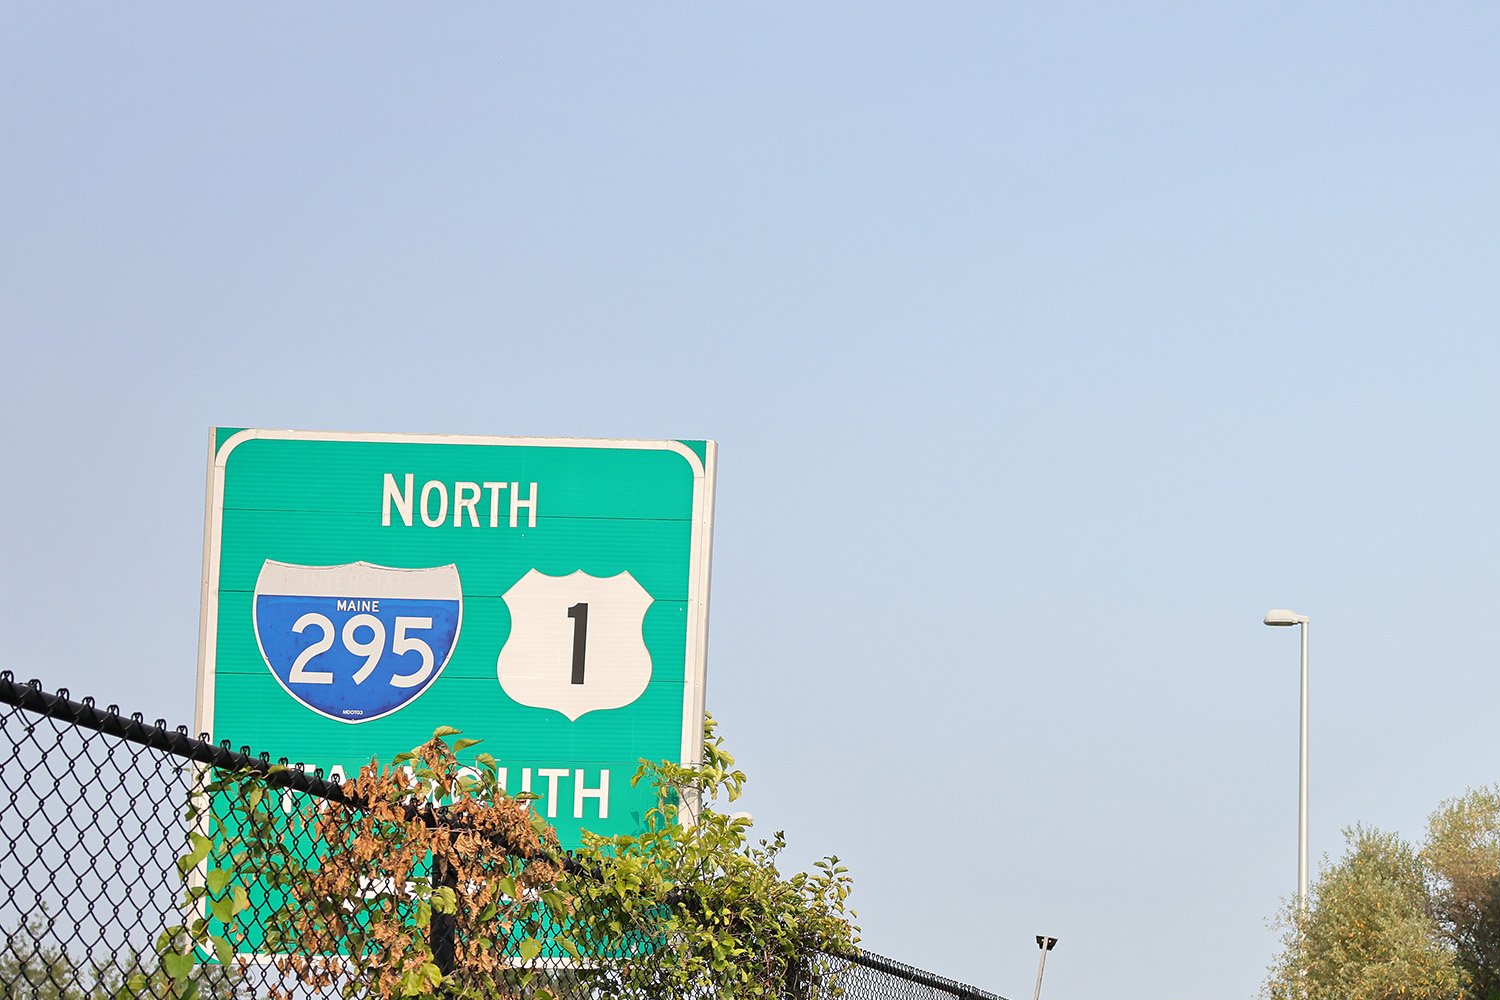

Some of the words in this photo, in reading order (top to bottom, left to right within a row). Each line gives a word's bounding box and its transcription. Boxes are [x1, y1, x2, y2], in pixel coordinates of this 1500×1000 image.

[381, 473, 538, 528] NORTH
[336, 600, 380, 613] MAINE
[288, 613, 434, 689] 295
[567, 602, 589, 685] 1
